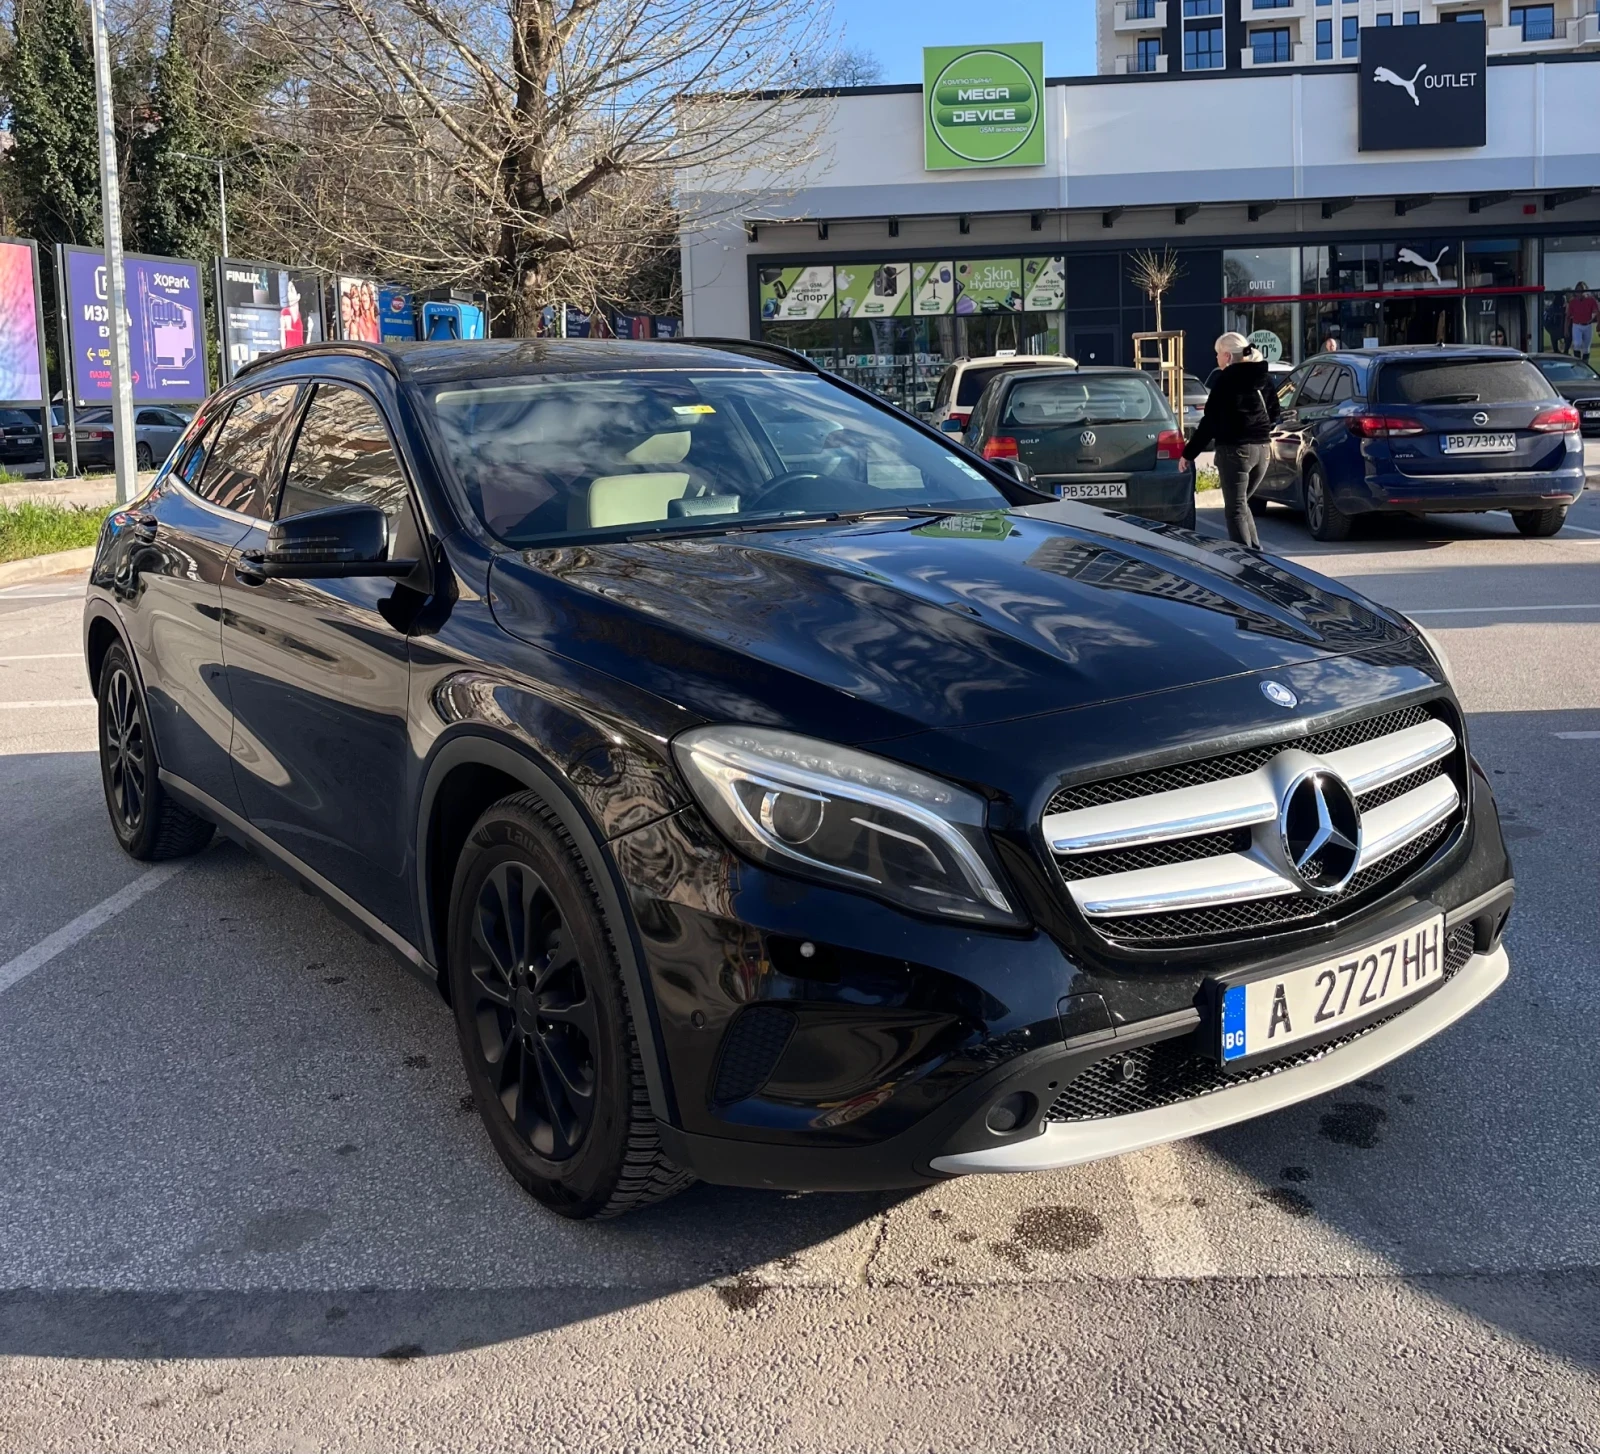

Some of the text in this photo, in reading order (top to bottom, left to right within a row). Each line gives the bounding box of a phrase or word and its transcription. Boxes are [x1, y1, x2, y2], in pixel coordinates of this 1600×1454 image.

[1424, 73, 1477, 89] OUTLET
[958, 87, 1010, 101] MEGA
[952, 108, 1016, 123] DEVICE
[226, 270, 260, 284] FINLUX
[984, 266, 1014, 280] Skin
[969, 278, 1020, 291] Hydrogel
[1249, 280, 1276, 290] OUTLET
[796, 292, 829, 303] Спорт
[1467, 435, 1496, 448] 7730
[1081, 485, 1107, 497] 5234
[1267, 983, 1292, 1039] A
[1225, 1030, 1244, 1049] BG
